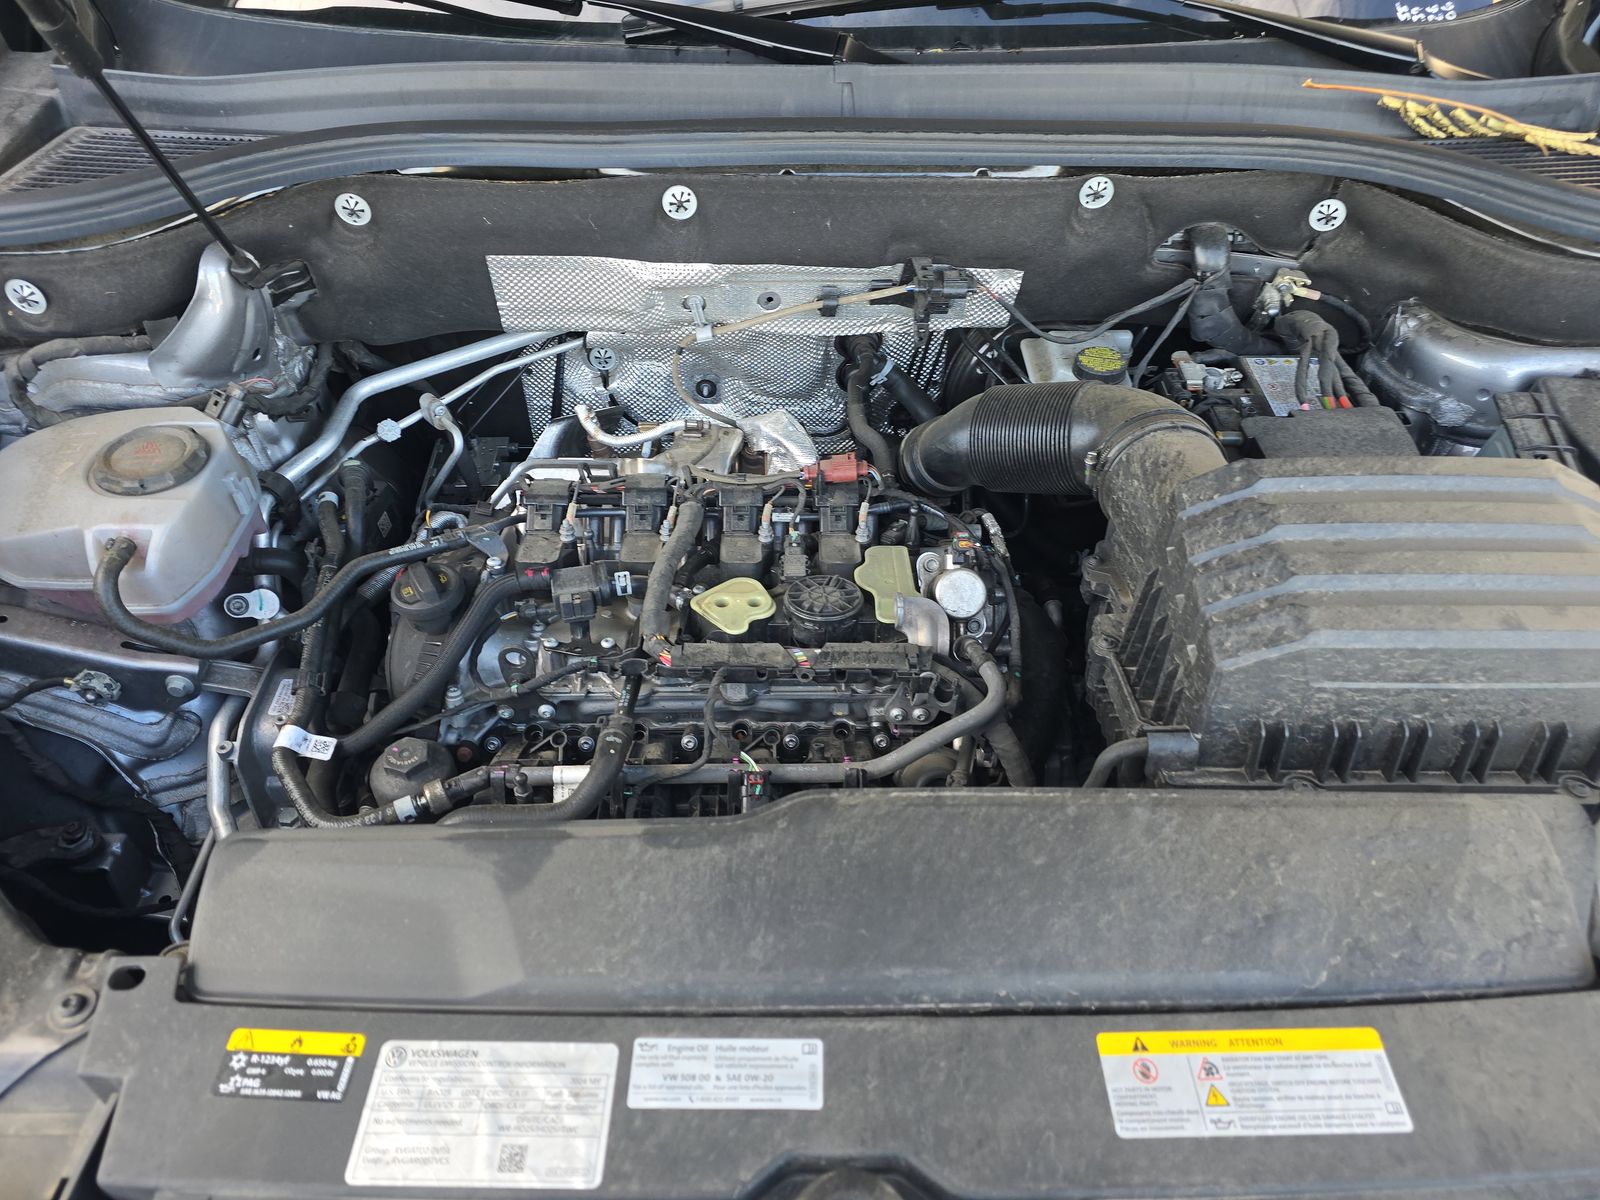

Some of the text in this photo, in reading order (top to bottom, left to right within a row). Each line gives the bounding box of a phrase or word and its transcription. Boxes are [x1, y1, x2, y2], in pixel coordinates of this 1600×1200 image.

[1169, 1036, 1283, 1049] WARNING ATTENTION
[410, 1048, 479, 1058] VOLKSWAGEN
[667, 1044, 709, 1054] Engine Oil
[715, 1043, 769, 1053] Huile moteur
[662, 1073, 678, 1081] VW
[698, 1073, 711, 1081] 00
[726, 1073, 742, 1082] SAE
[744, 1073, 774, 1082] 0W-20
